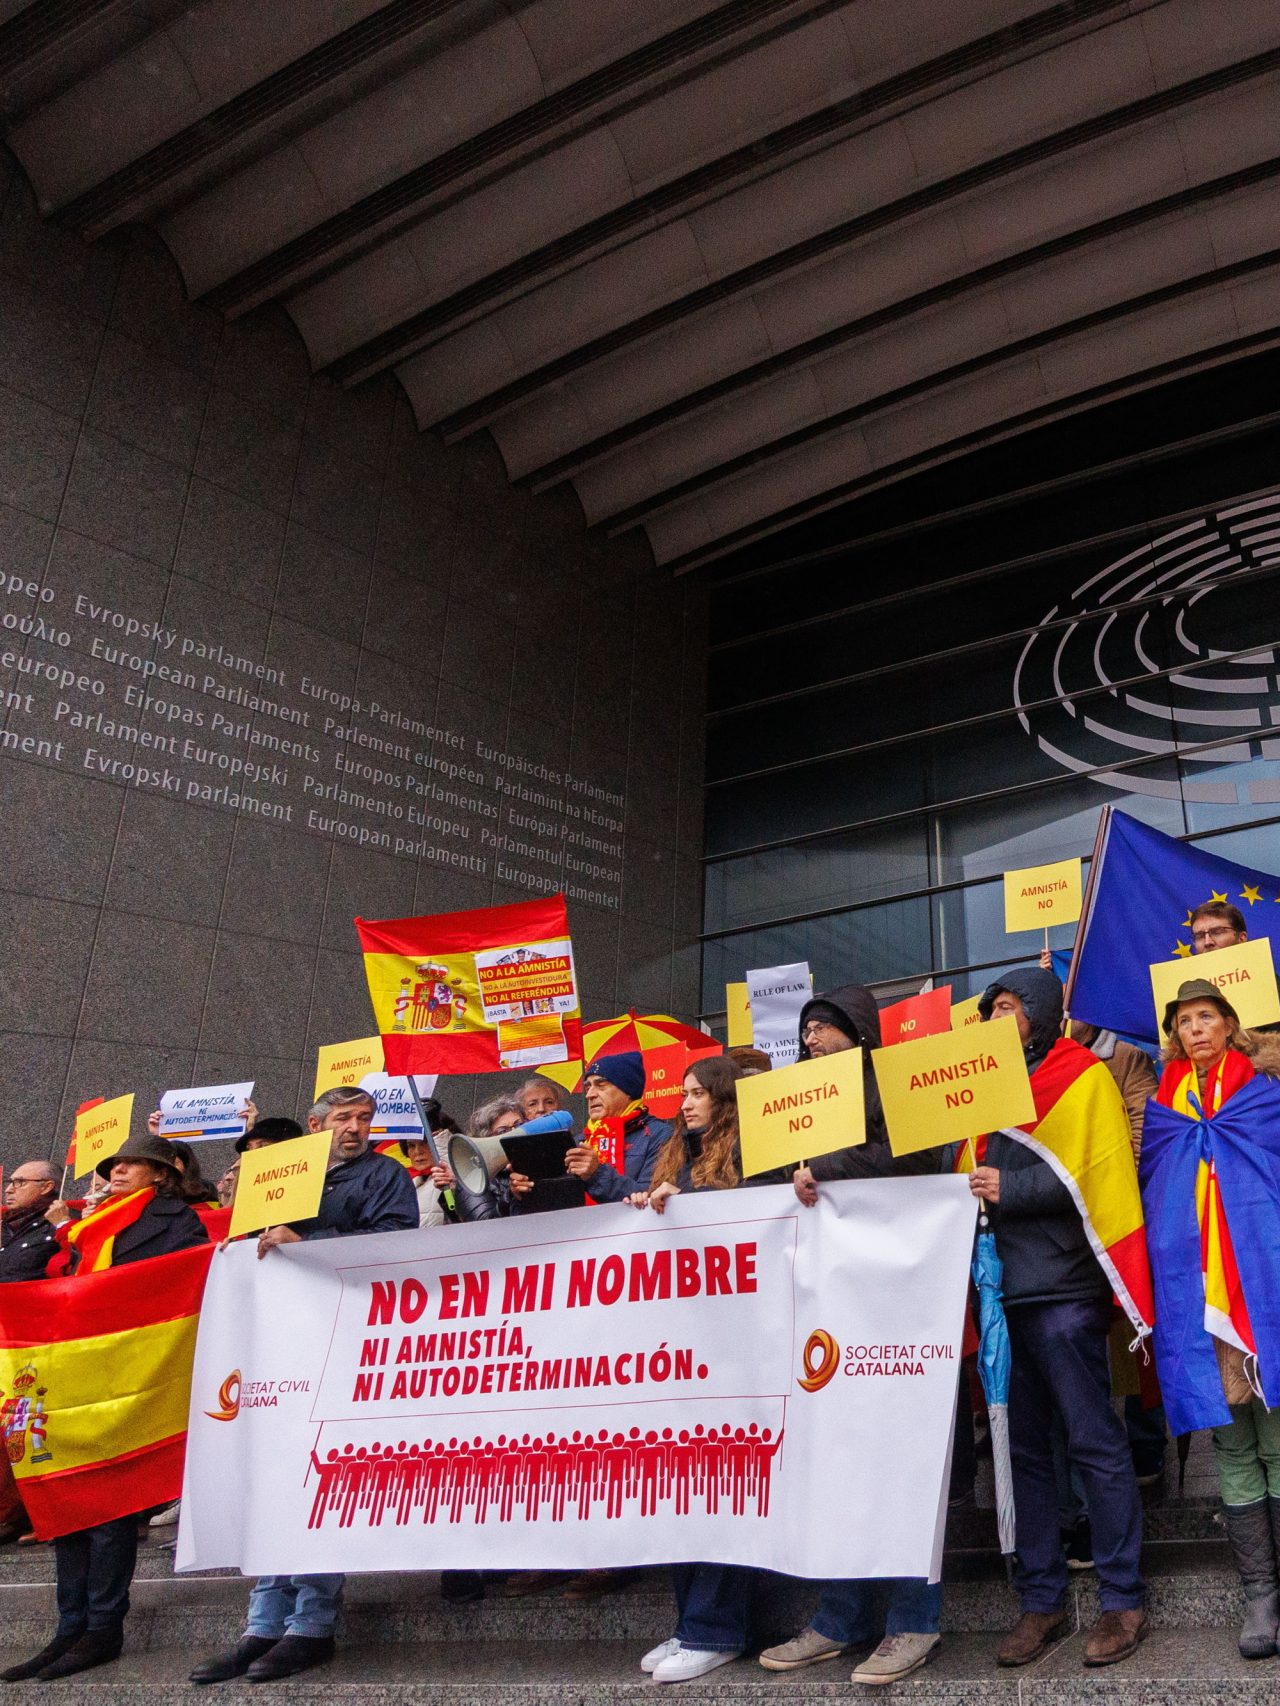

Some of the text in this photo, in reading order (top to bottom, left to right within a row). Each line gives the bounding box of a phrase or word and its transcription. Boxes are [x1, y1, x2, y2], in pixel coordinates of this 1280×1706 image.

[74, 594, 177, 650] Evropský
[182, 637, 287, 687] parlament
[300, 677, 466, 750] Europa-Parlamentet
[476, 741, 561, 784] Europäisches
[564, 774, 624, 808] Parlament
[91, 638, 623, 833] European Parliament Parlement européen Parlaimint na hEorpa
[2, 652, 622, 858] europeo Eiropas Parlaments Europos Parlamentas Európai Parlament
[55, 702, 177, 754] Parlament
[183, 740, 288, 786] Europejski
[303, 775, 403, 818] Parlamento
[408, 806, 469, 838] Europeu
[481, 828, 562, 866] Parlamentul
[566, 853, 621, 883] European
[84, 748, 181, 792] Evropski
[186, 781, 293, 822] parlament
[308, 809, 390, 847] Euroopan
[395, 838, 486, 874] parlamentti
[497, 862, 619, 909] Europaparlamentet
[1021, 880, 1067, 897] AMNISTÍA
[1038, 898, 1054, 910] NO
[480, 957, 567, 980] NO A LA AMNISTÍA
[485, 985, 570, 1004] NO AL REFERÉNDUM
[753, 983, 806, 998] RULE OF LAW
[900, 1019, 916, 1033] NO
[331, 1053, 371, 1072] AMNISTÍA
[909, 1053, 999, 1091] AMNISTÍA
[341, 1074, 355, 1084] NO
[652, 1069, 665, 1080] NO
[371, 1089, 405, 1100] NO EN
[645, 1088, 654, 1099] mi
[762, 1082, 840, 1117] AMNISTÍA
[945, 1089, 975, 1109] NO
[84, 1117, 118, 1140] AMNISTÍA
[788, 1114, 814, 1133] NO
[91, 1139, 103, 1151] NO
[253, 1159, 308, 1186] AMNISTÍA
[265, 1187, 285, 1202] NO
[366, 1241, 758, 1326] NO EN MI NOMBRE
[359, 1320, 533, 1367] NI AMNISTÍA,
[845, 1344, 954, 1360] SOCIETAT CIVIL
[352, 1342, 709, 1402] NI AUTODETERMINACIÓN.
[844, 1361, 925, 1376] CATALANA
[278, 1380, 310, 1393] CIVIL
